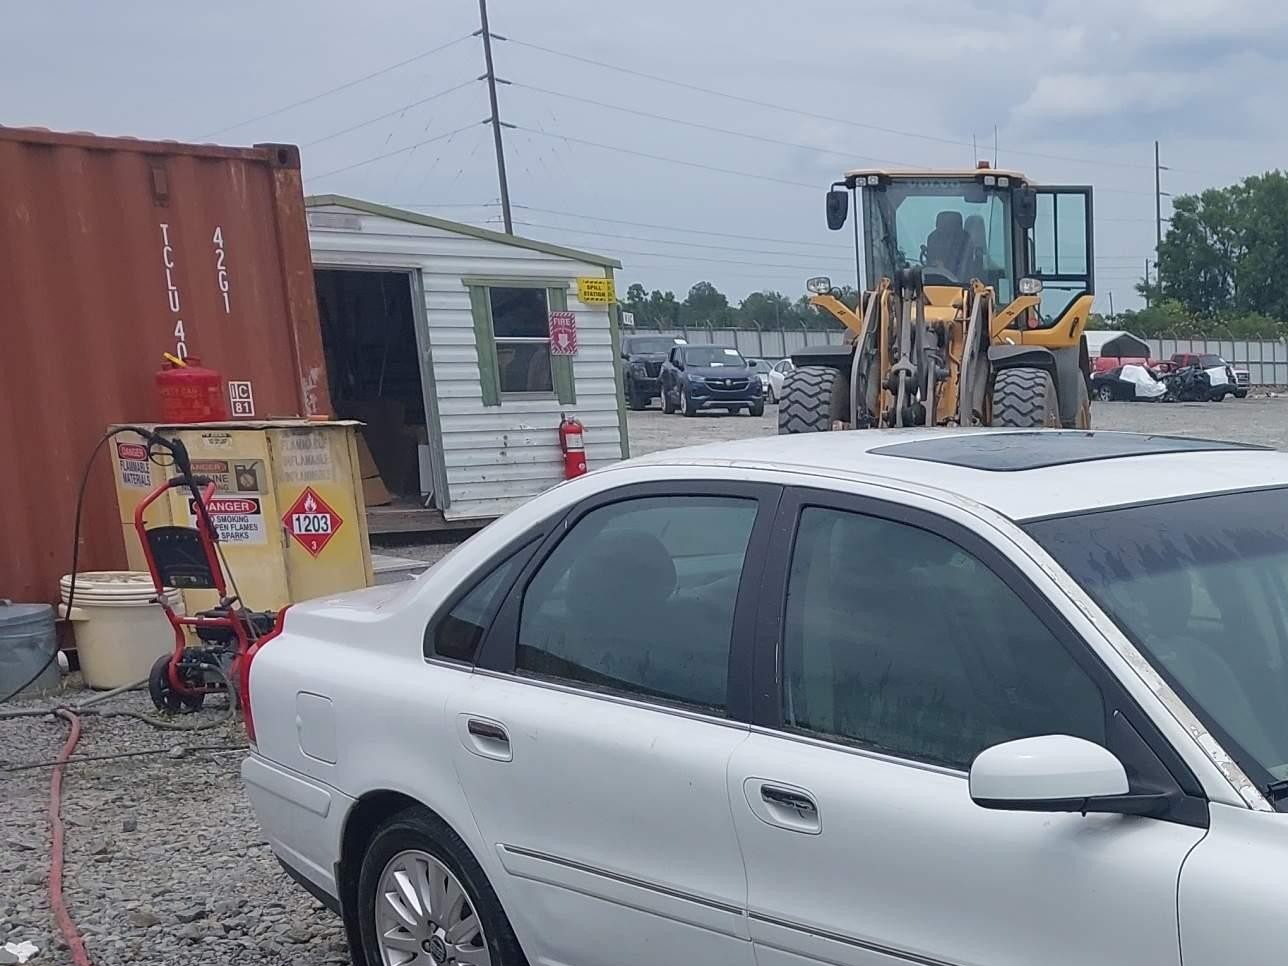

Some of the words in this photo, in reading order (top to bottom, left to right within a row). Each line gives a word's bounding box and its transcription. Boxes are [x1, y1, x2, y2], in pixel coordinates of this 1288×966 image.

[160, 223, 180, 312] TCLU
[213, 226, 230, 313] 42G1
[553, 317, 571, 326] FIRE
[235, 401, 250, 413] 81
[121, 447, 144, 457] DANGER
[120, 460, 150, 473] FLAMMABLE
[191, 463, 224, 471] ANGER
[123, 473, 151, 486] MATERIALS
[206, 502, 250, 511] ANGER
[216, 515, 249, 523] SMOKING
[295, 515, 329, 532] 1203
[311, 540, 317, 550] 3
